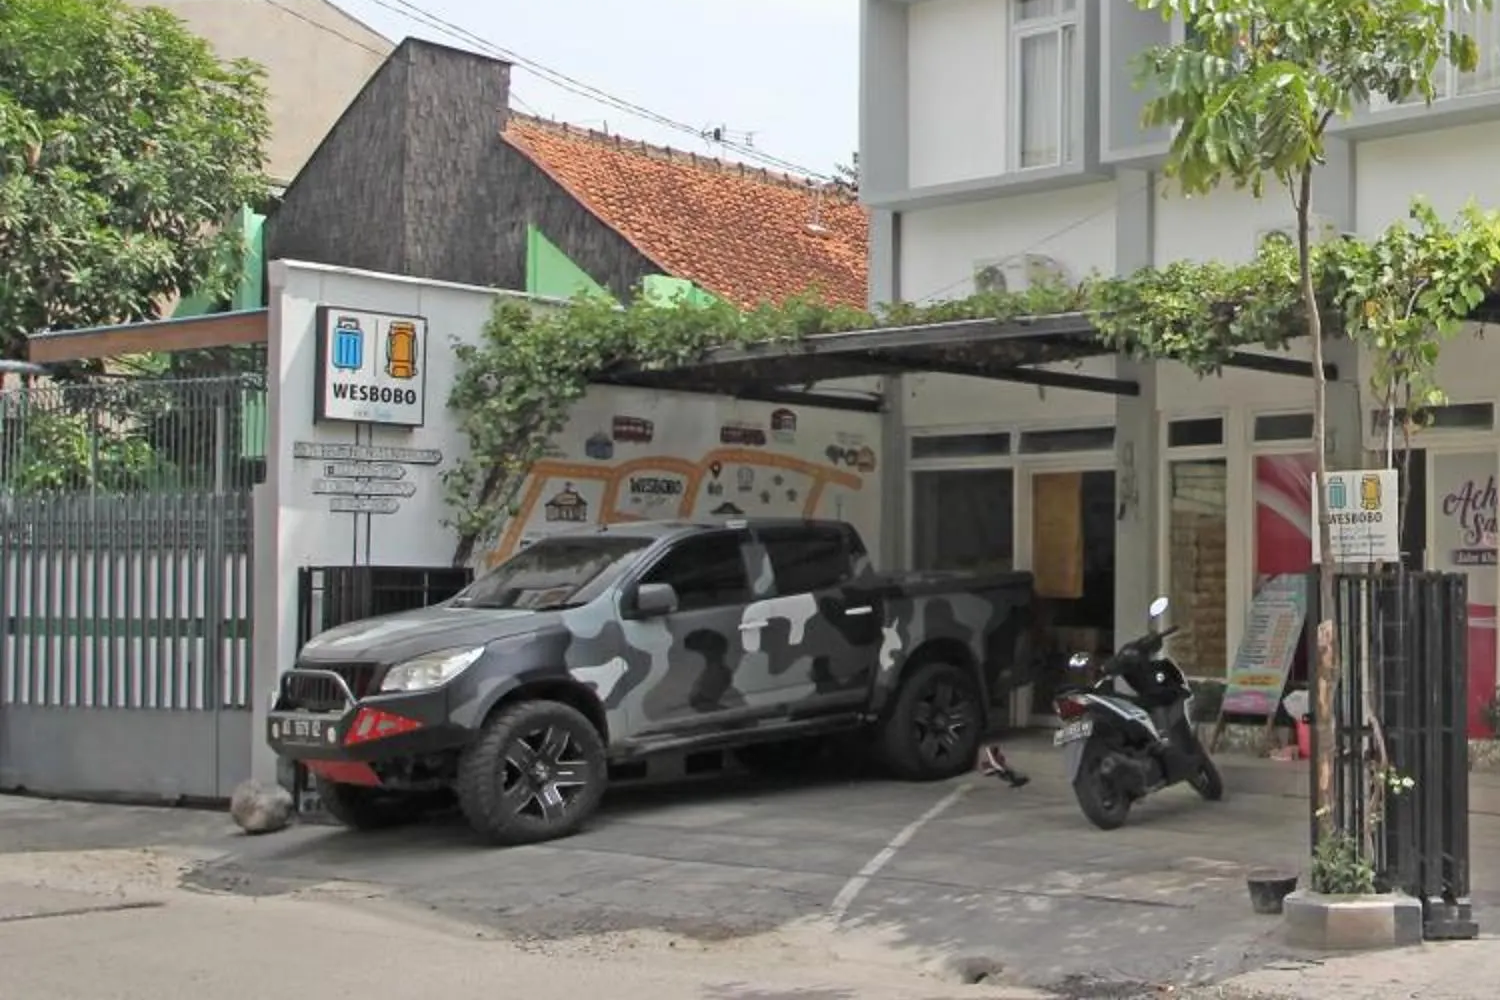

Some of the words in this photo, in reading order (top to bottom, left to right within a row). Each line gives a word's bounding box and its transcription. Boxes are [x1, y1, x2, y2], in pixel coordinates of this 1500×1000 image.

[333, 382, 417, 405] WESBOBO
[629, 477, 683, 495] WESBOBO
[1442, 475, 1498, 529] Ach
